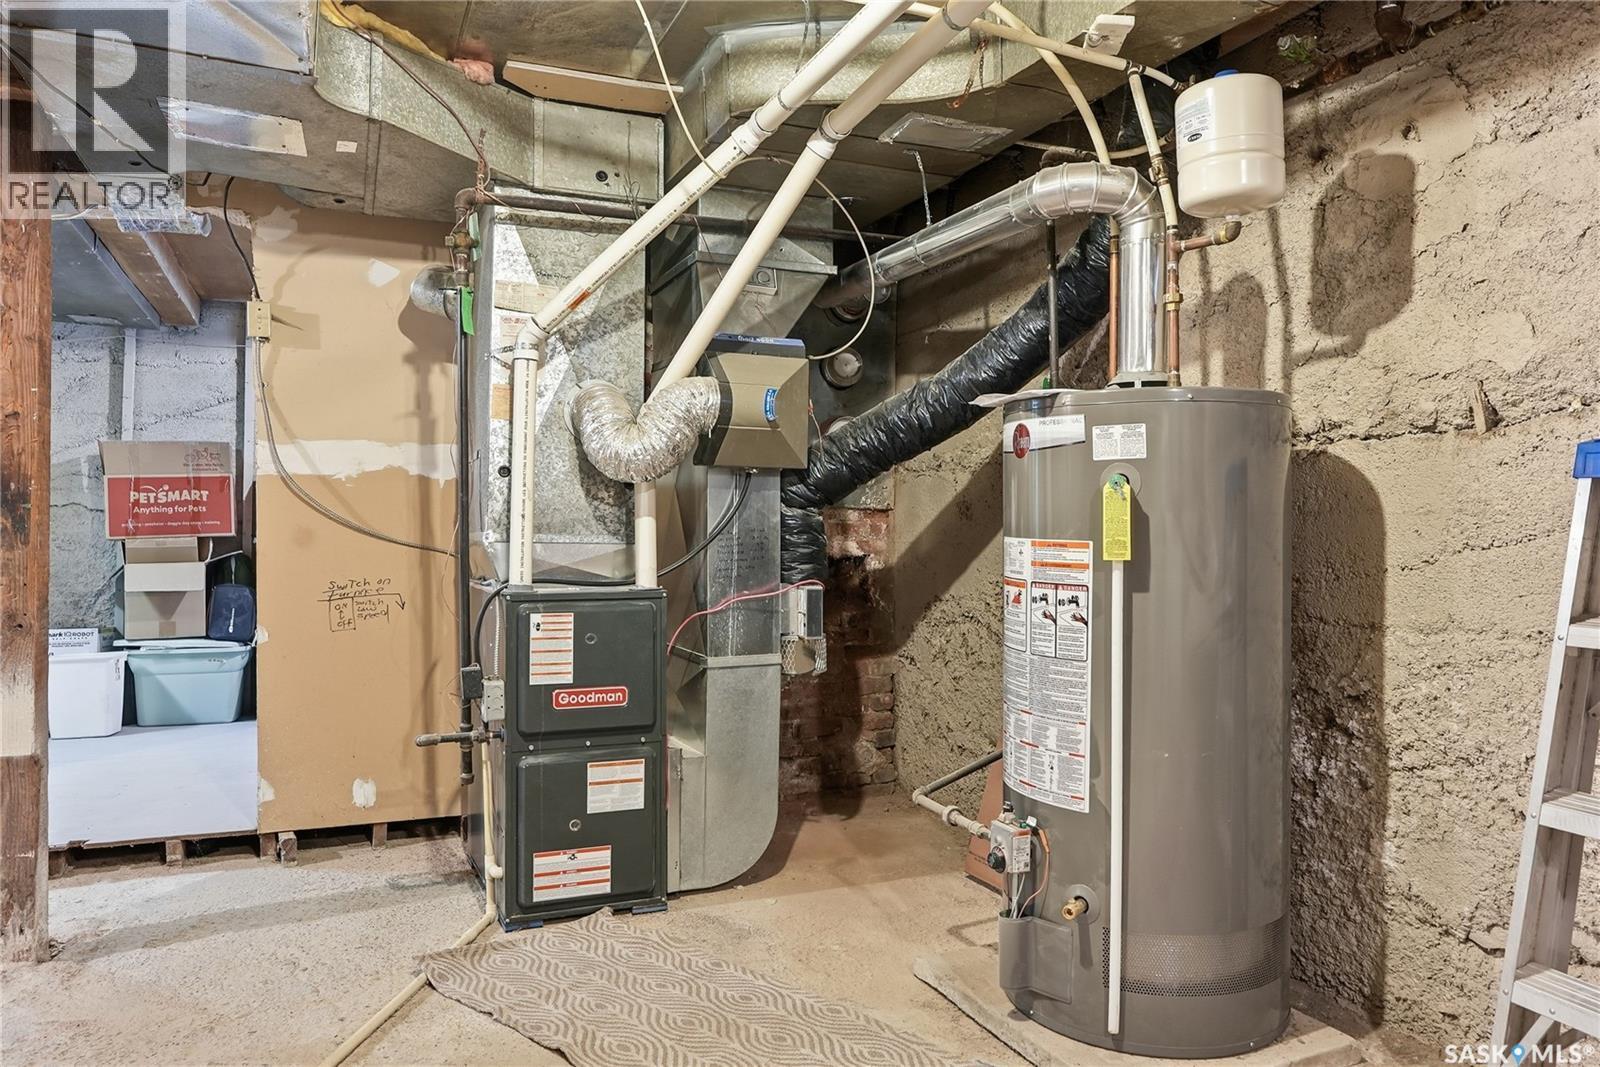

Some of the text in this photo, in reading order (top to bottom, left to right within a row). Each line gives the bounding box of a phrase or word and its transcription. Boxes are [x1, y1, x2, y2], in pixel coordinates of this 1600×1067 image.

[130, 489, 209, 503] PETSMART
[133, 504, 207, 515] Anything for Pets
[558, 691, 623, 705] Goodman
